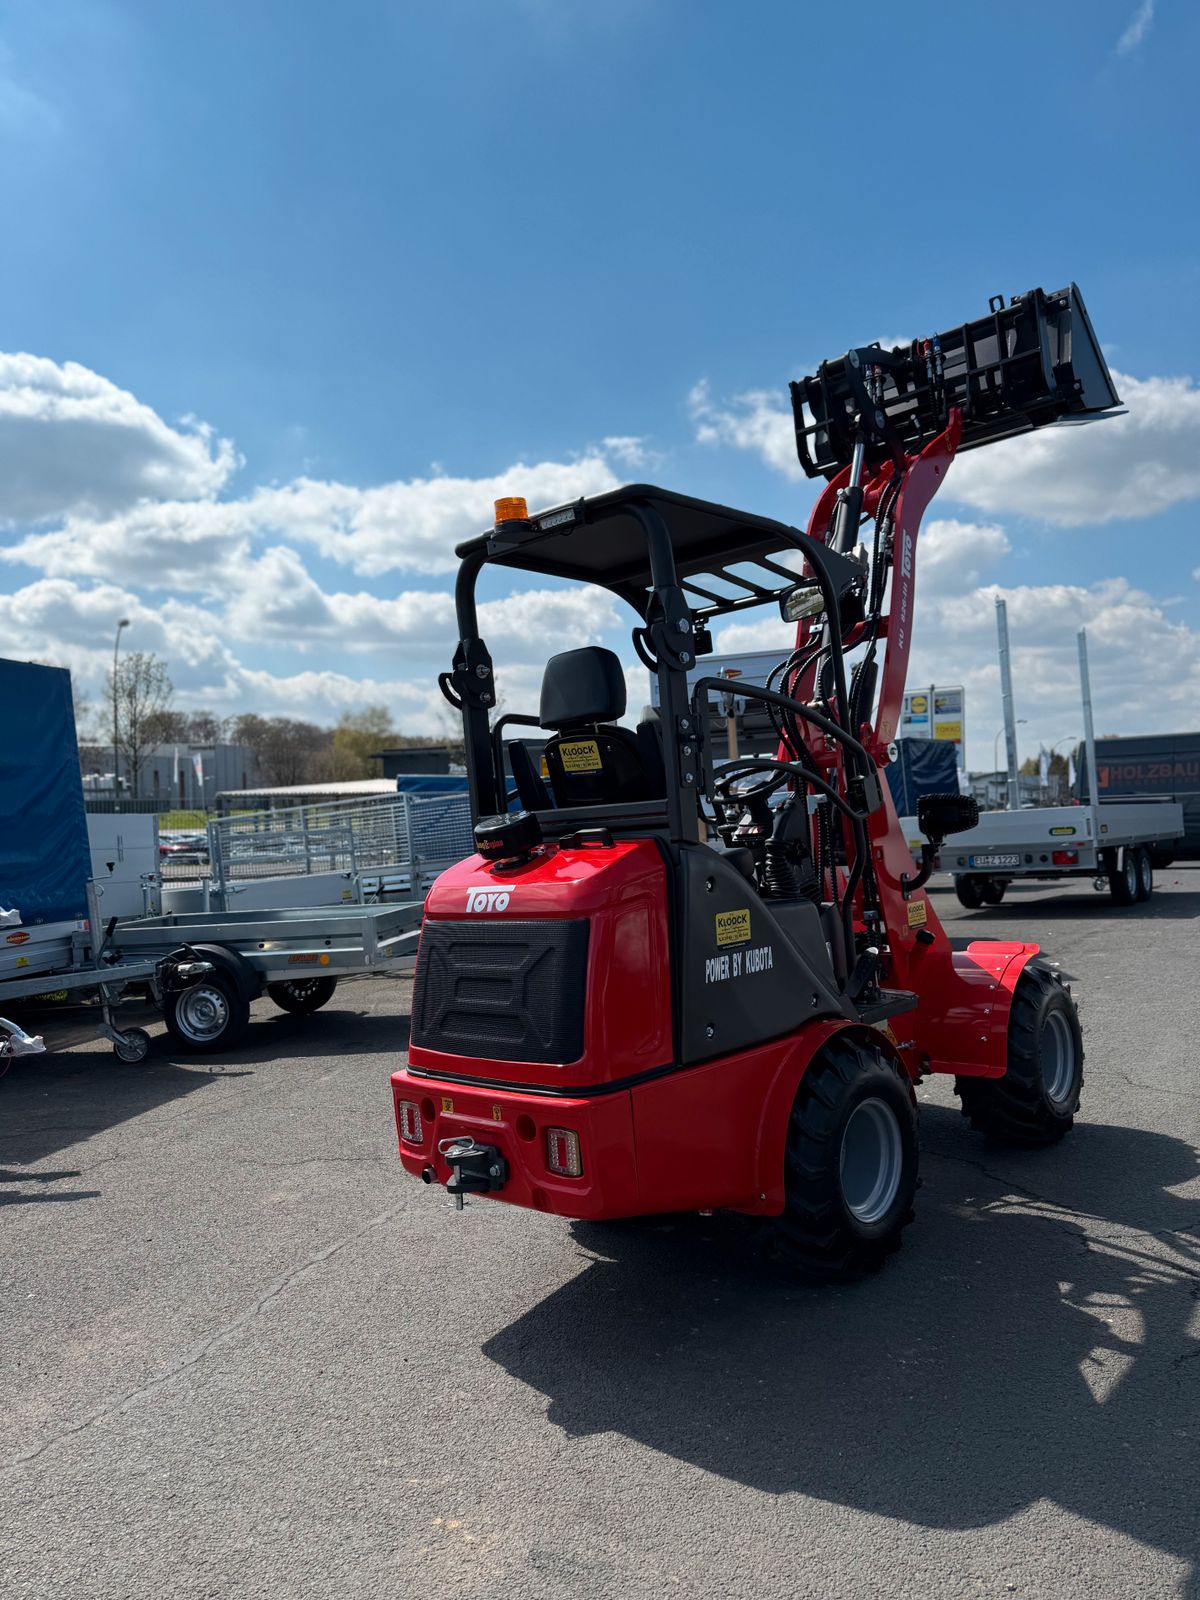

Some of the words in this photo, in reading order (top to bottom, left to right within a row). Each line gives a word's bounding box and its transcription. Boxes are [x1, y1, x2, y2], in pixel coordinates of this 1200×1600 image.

[901, 528, 912, 578] TOYO
[561, 745, 596, 757] KLOOCK
[1110, 762, 1200, 782] HOLZBAU
[466, 885, 517, 913] TOYO
[718, 913, 748, 928] KLOOCK
[705, 955, 730, 984] POWER
[732, 952, 742, 977] BY
[745, 946, 773, 974] KUBOTA
